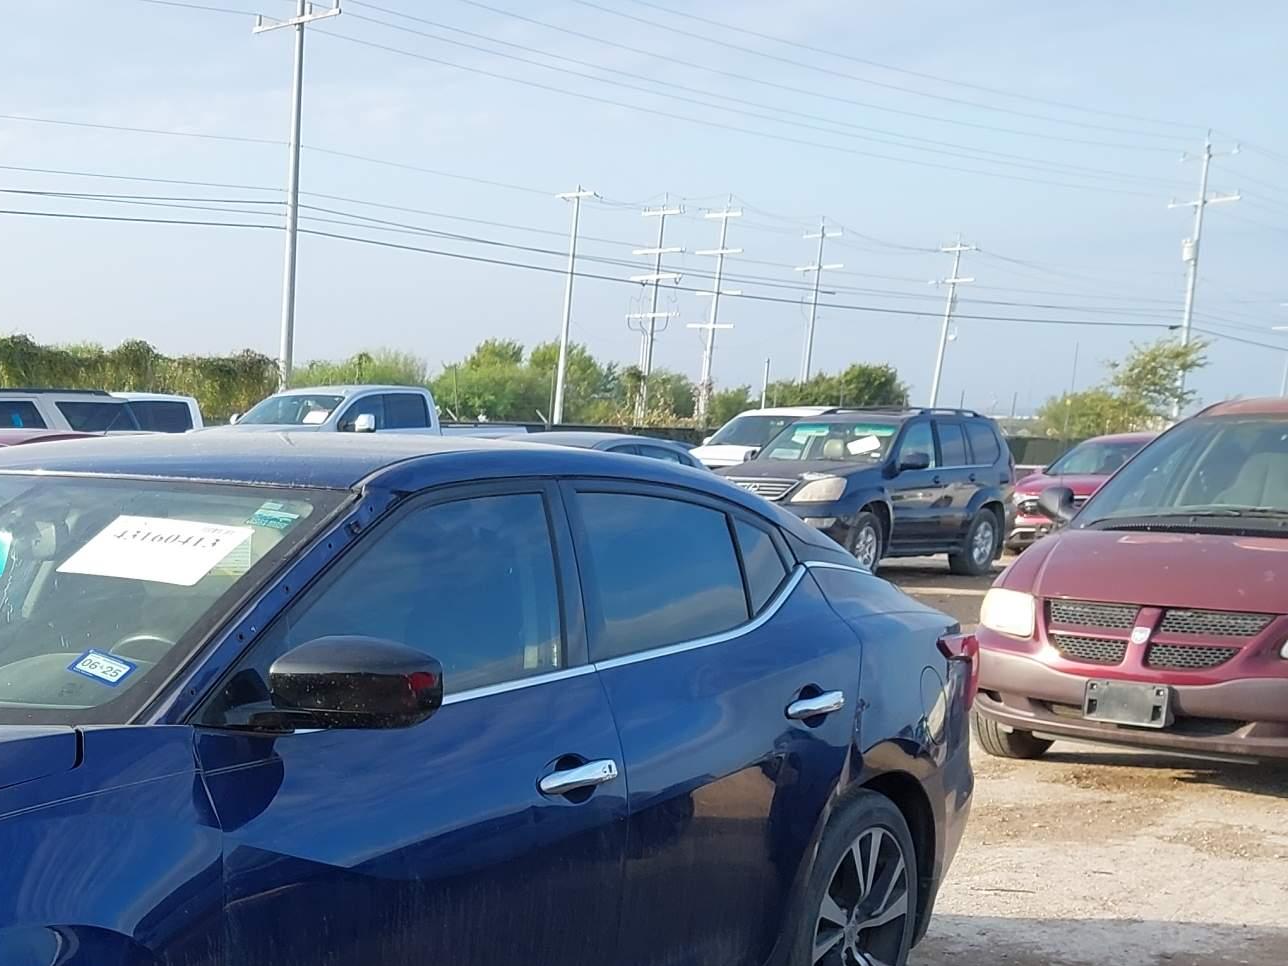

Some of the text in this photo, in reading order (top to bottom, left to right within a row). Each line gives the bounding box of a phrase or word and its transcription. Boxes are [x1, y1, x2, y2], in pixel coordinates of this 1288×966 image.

[113, 529, 221, 548] 43160413
[82, 658, 100, 670] 06
[102, 666, 122, 678] 25
